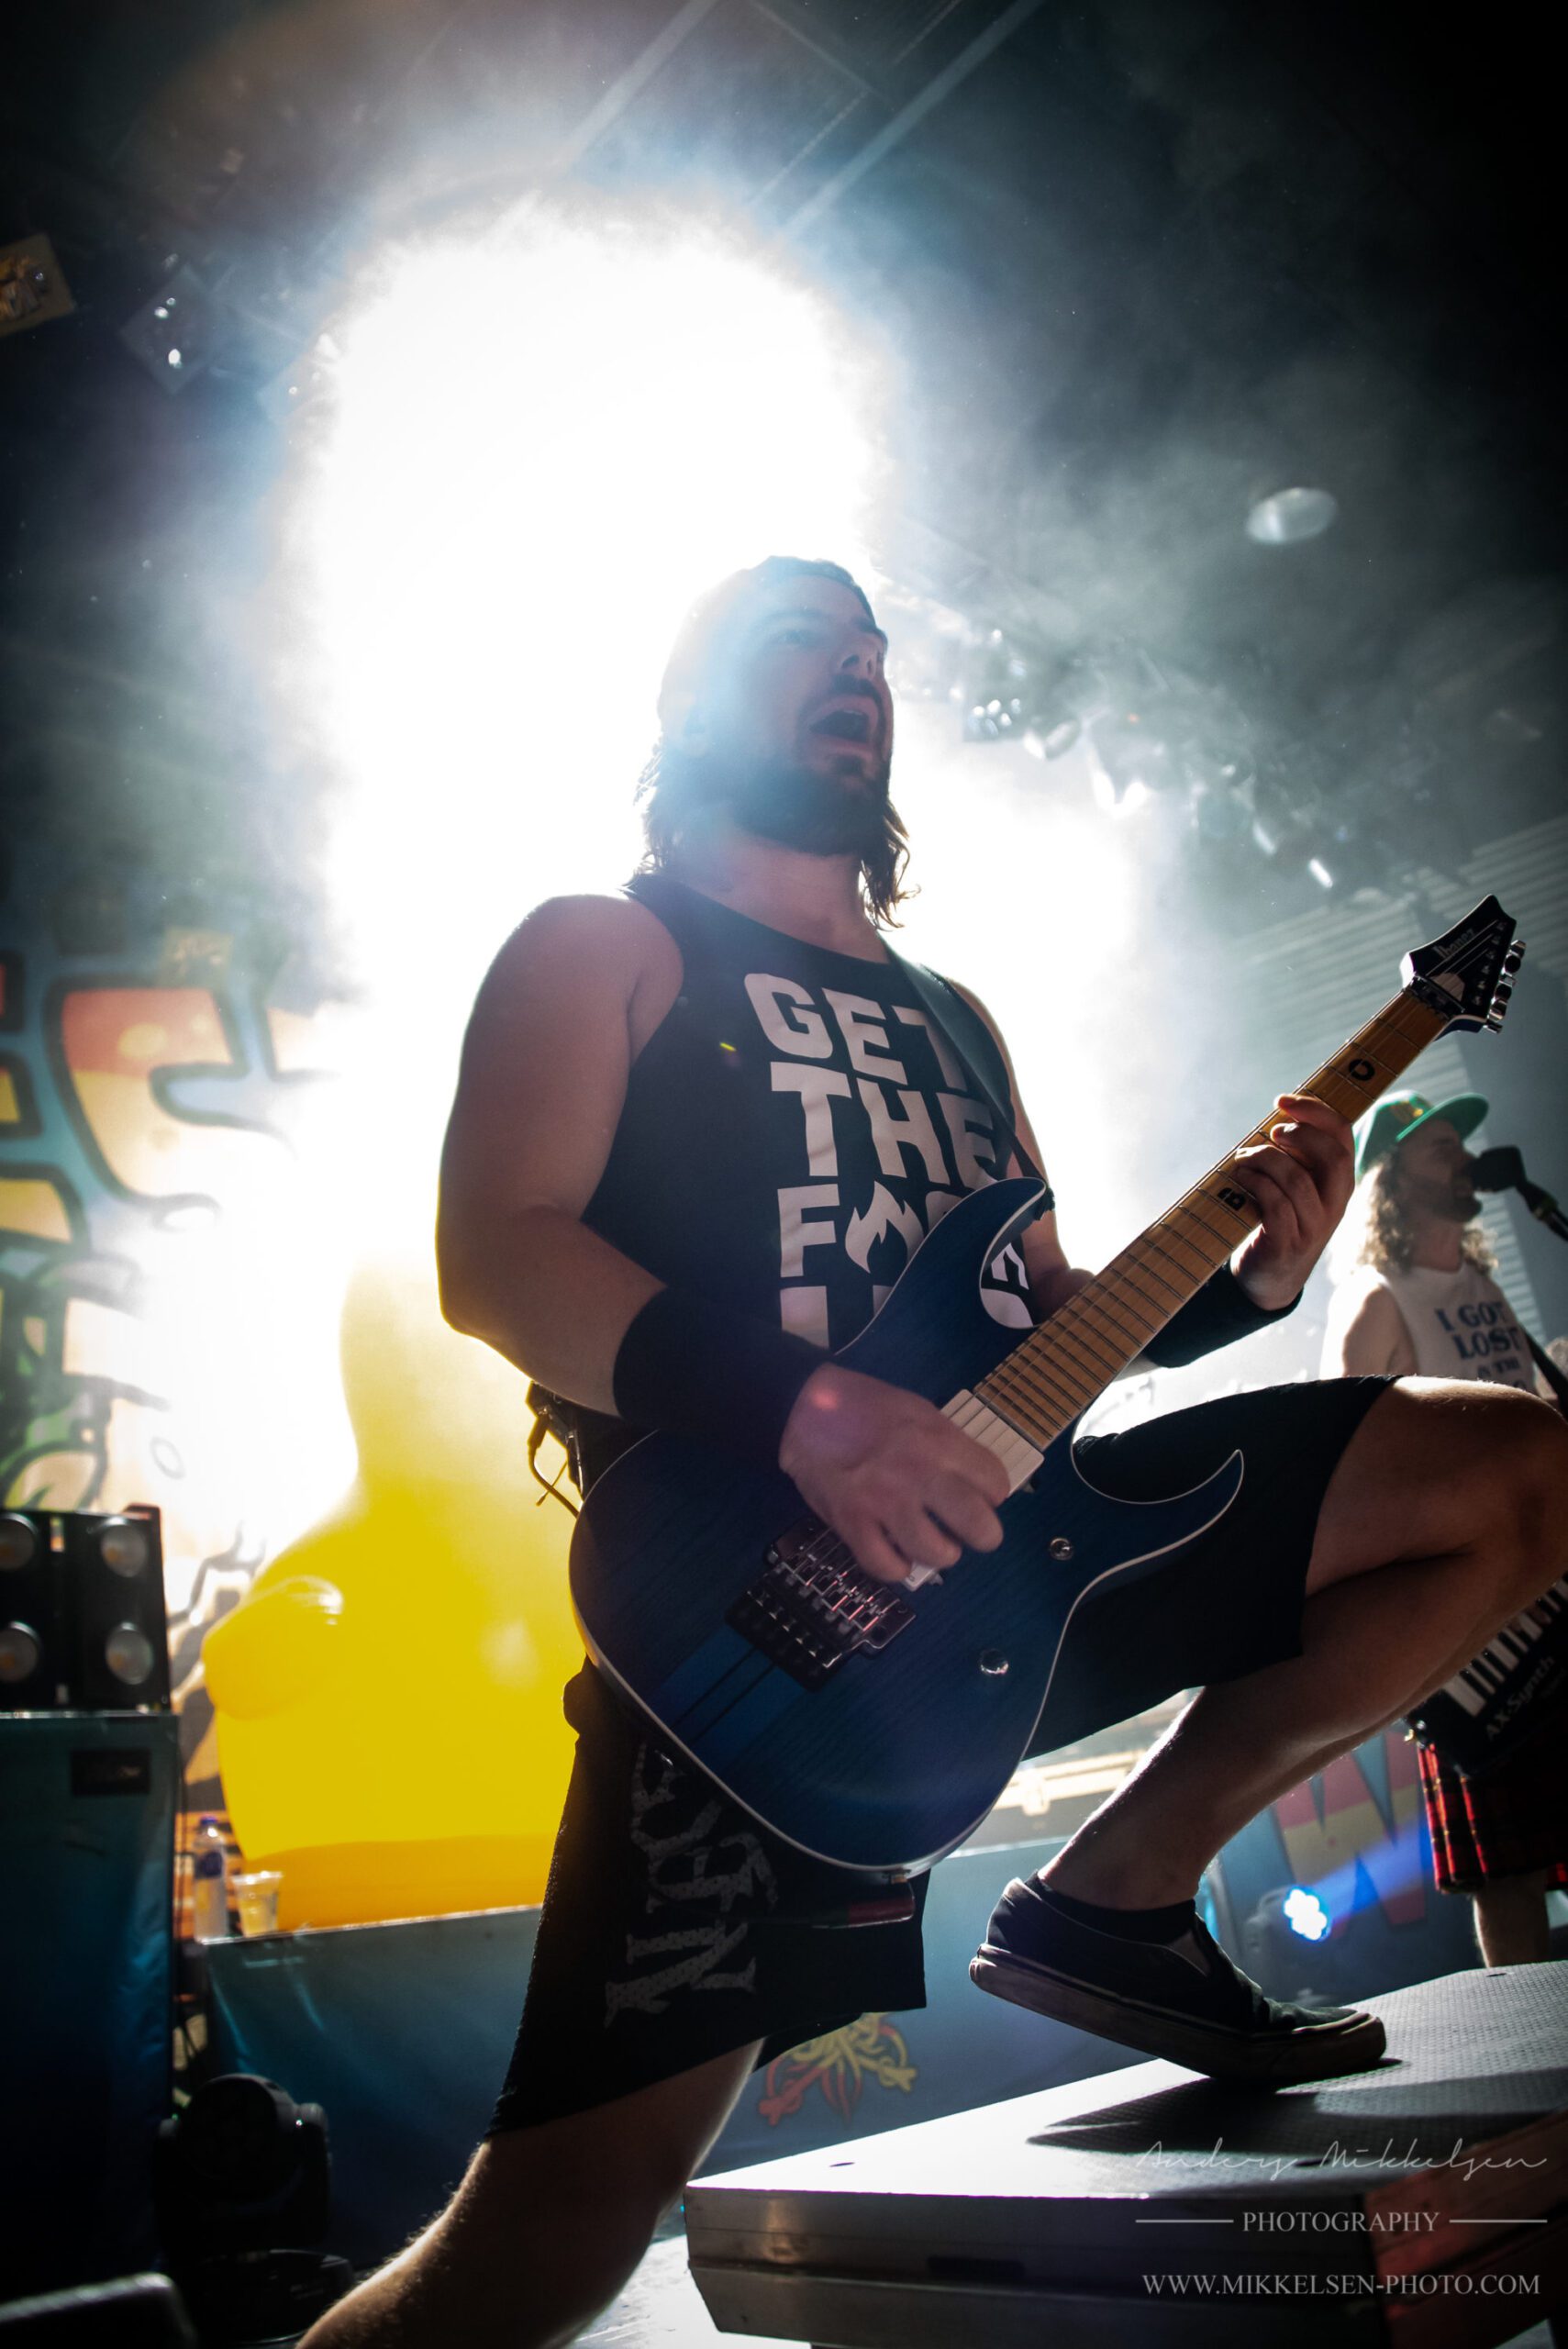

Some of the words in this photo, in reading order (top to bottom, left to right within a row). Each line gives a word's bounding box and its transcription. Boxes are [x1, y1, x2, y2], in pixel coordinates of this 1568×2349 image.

[744, 973, 967, 1092] GET
[770, 1061, 1002, 1190] THE
[1435, 1308, 1452, 1331] I
[1458, 1301, 1507, 1328] GOT
[1452, 1327, 1520, 1360] LOST
